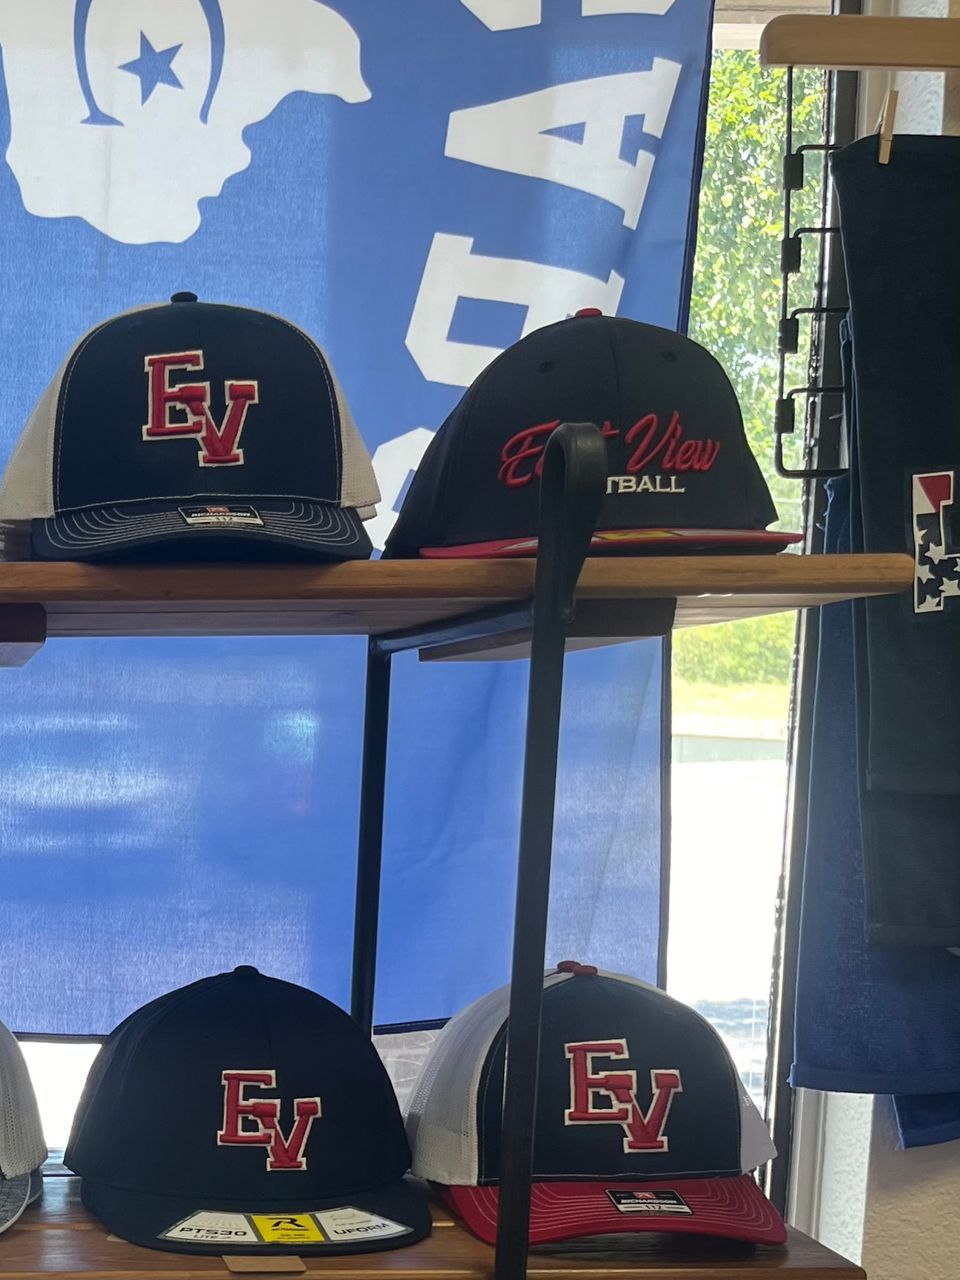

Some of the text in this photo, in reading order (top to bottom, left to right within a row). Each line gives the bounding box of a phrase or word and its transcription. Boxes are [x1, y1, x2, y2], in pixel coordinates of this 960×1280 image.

[142, 350, 259, 468] EV
[625, 410, 721, 474] View
[606, 475, 686, 494] TBALL
[217, 1069, 322, 1172] EV
[563, 1038, 683, 1154] EV
